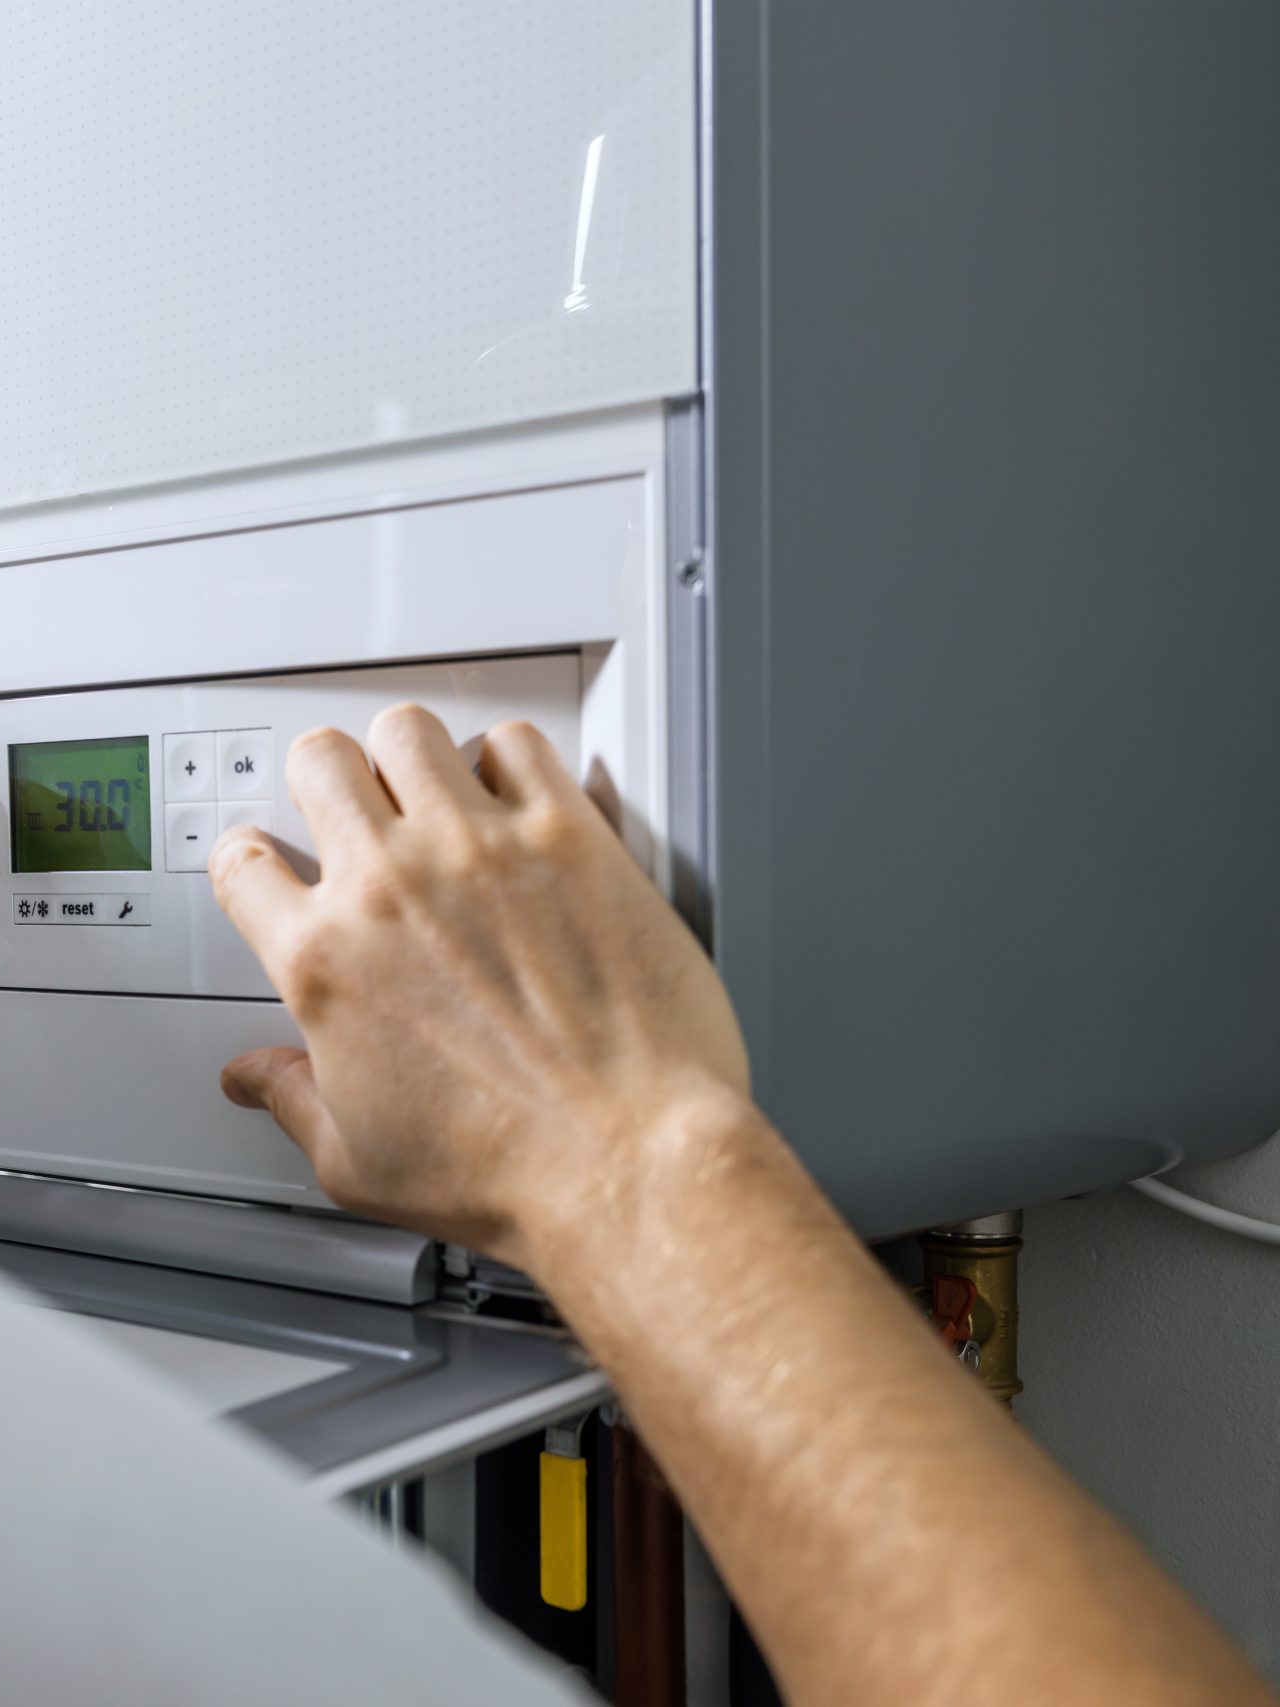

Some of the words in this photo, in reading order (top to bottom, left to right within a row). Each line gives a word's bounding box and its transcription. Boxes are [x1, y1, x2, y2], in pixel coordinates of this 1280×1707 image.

[234, 756, 254, 773] ok
[55, 779, 130, 832] 30.0
[62, 902, 94, 915] reset
